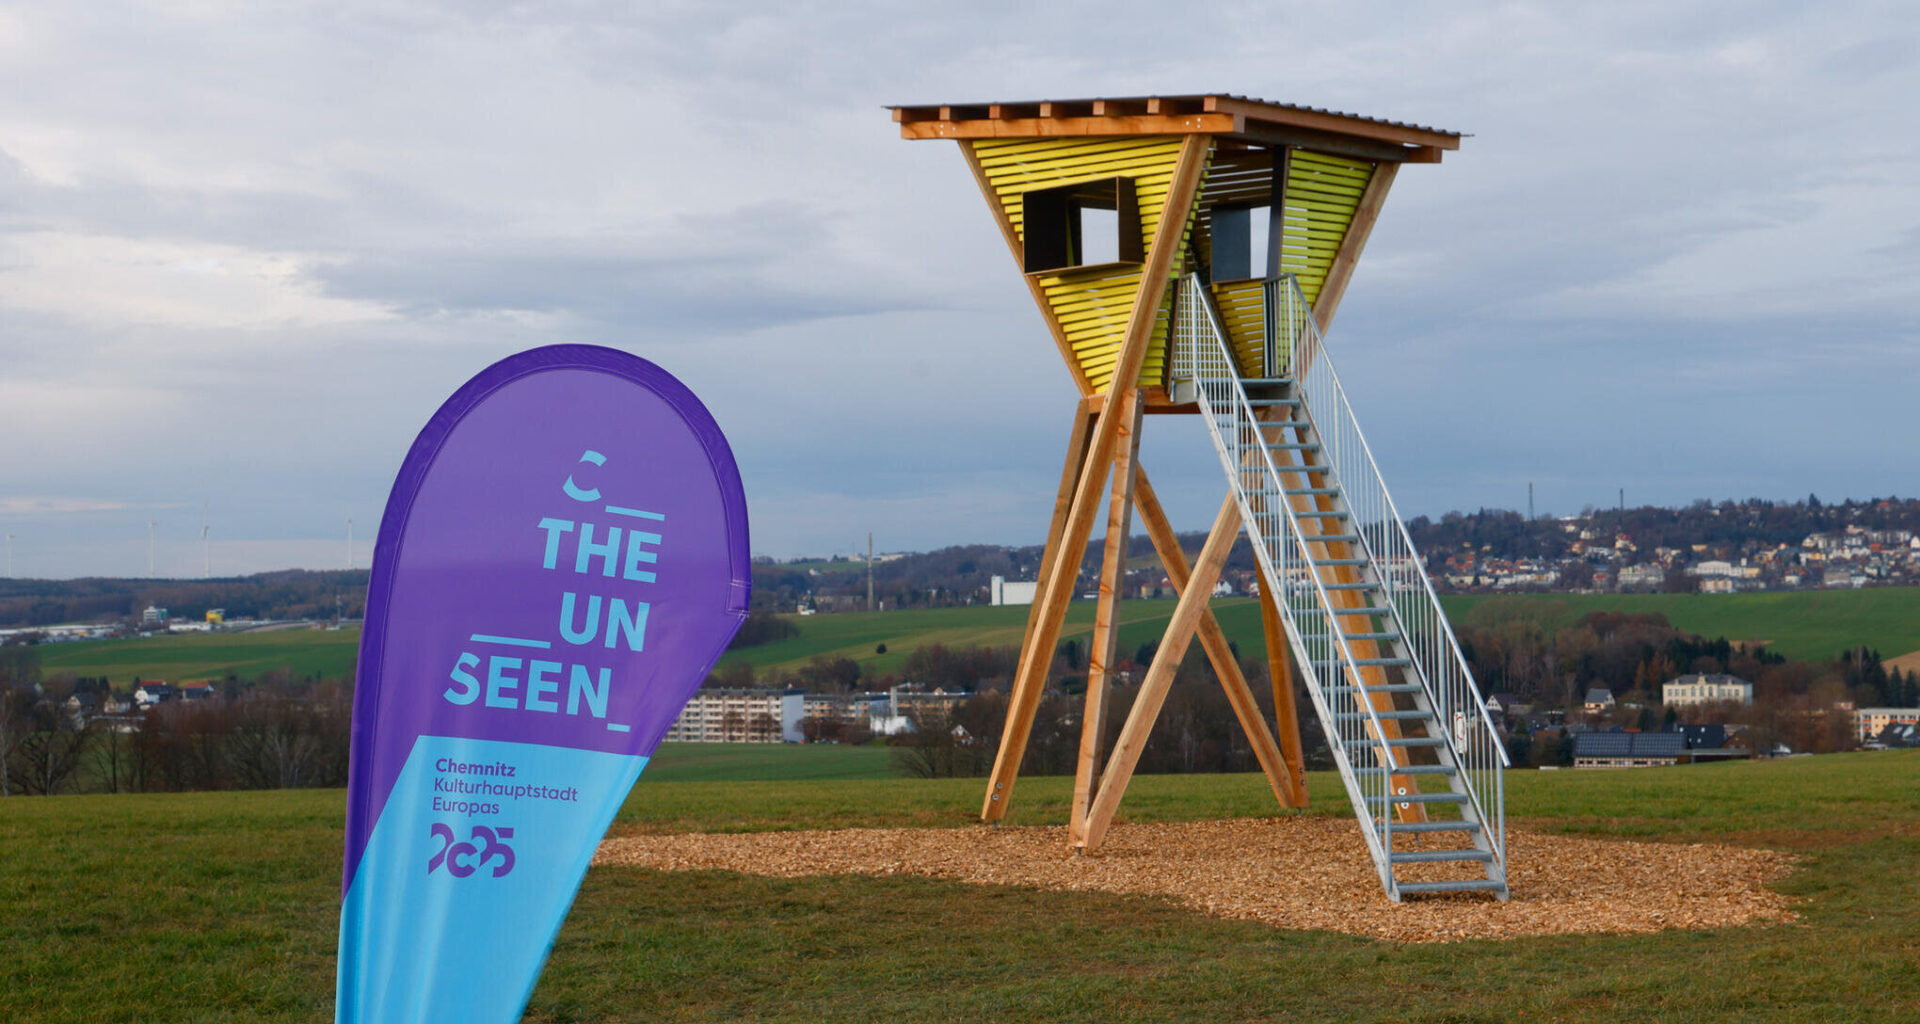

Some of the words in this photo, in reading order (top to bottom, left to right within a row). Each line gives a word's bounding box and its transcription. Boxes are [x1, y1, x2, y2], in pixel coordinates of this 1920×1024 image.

[538, 518, 663, 584] THE
[435, 757, 517, 777] Chemnitz
[434, 776, 578, 802] Kulturhauptstadt
[432, 796, 500, 817] Europas
